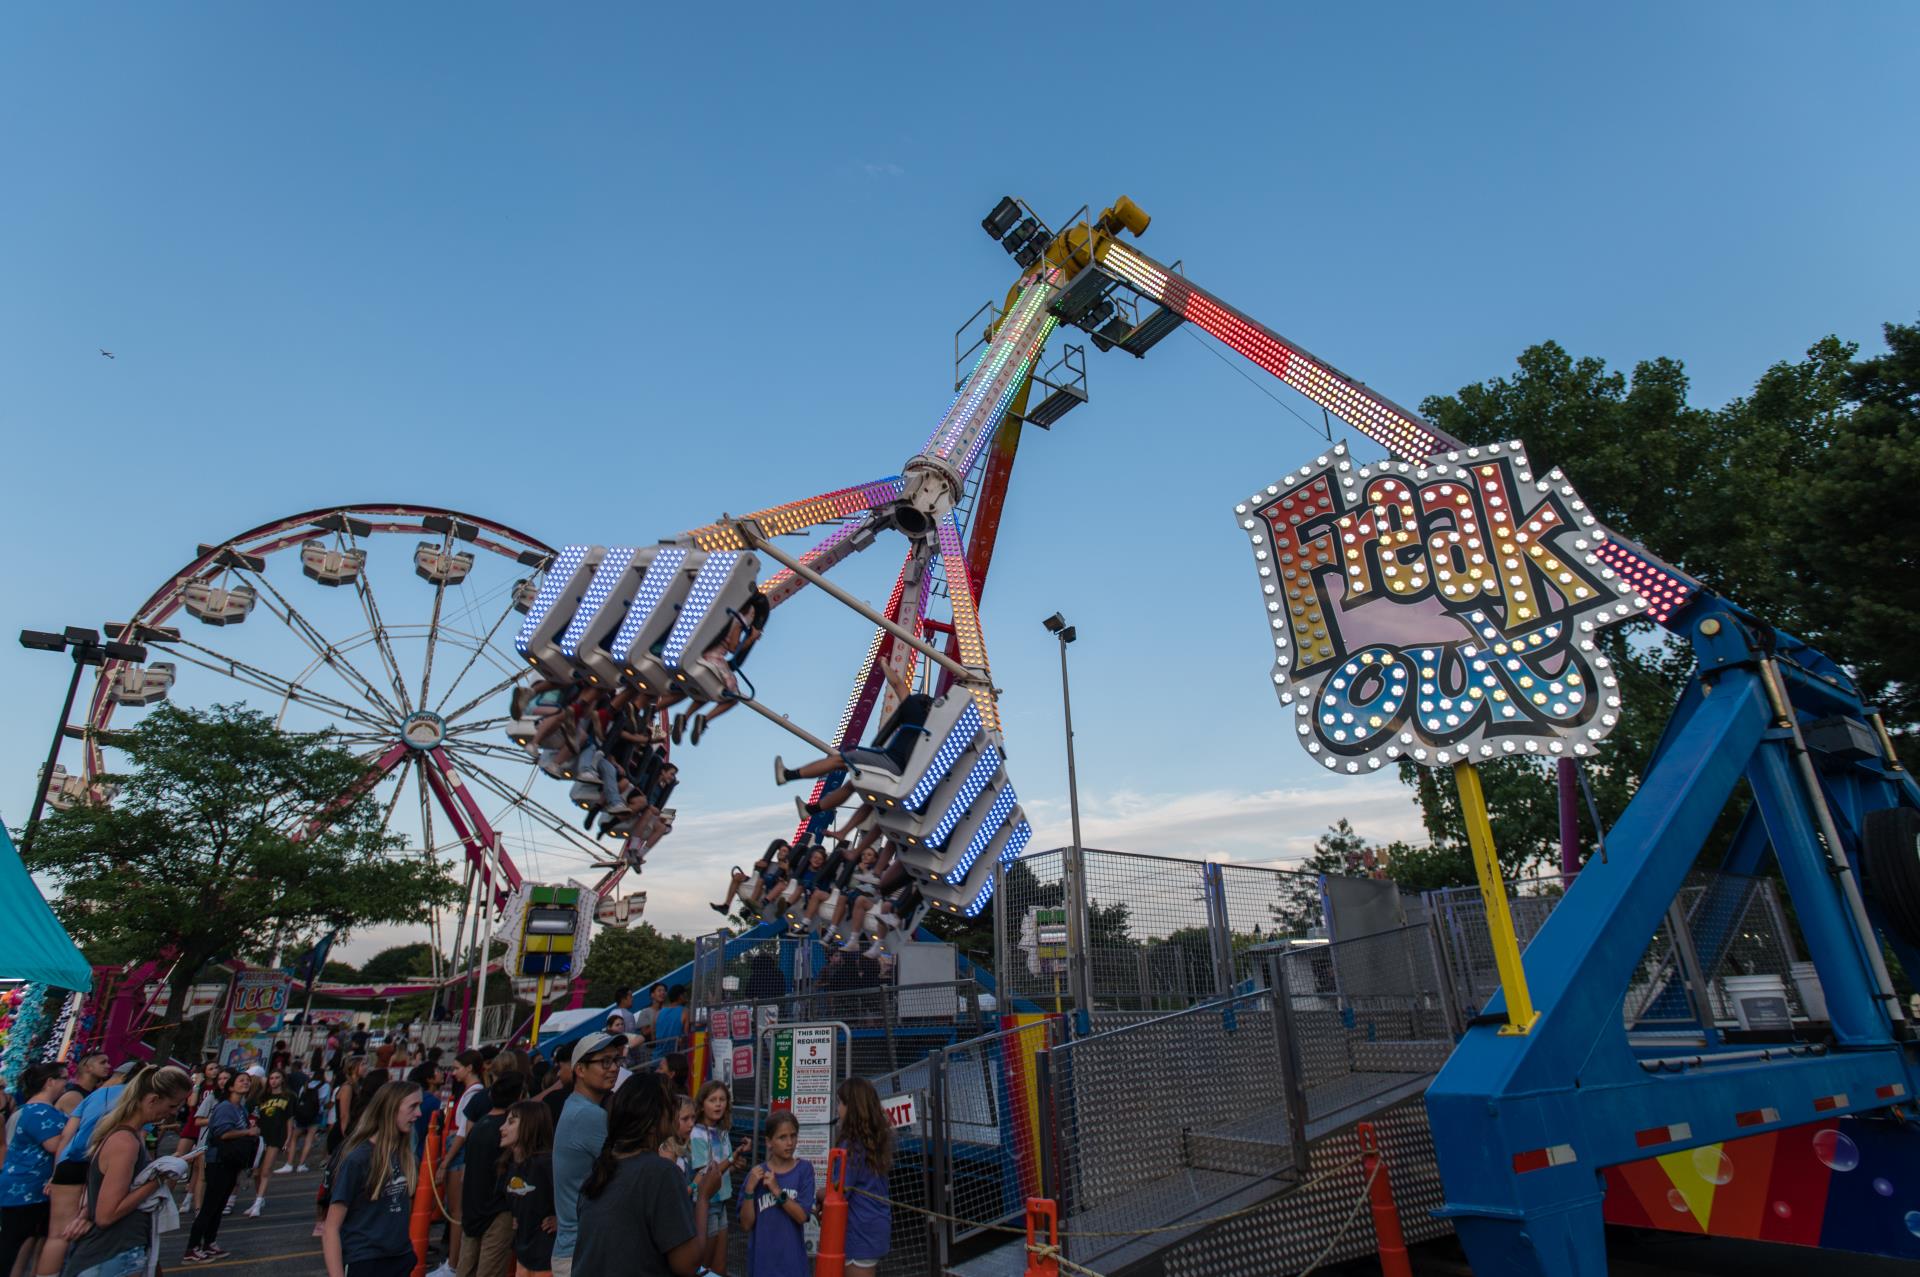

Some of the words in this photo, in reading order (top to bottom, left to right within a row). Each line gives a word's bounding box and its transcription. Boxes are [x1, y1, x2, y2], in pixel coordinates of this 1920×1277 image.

[1256, 458, 1617, 676] Freak
[235, 985, 285, 1011] TICKETS
[809, 1046, 817, 1056] 5
[777, 1056, 789, 1089] YES
[797, 1097, 827, 1105] SAFETY
[886, 1103, 911, 1126] XIT
